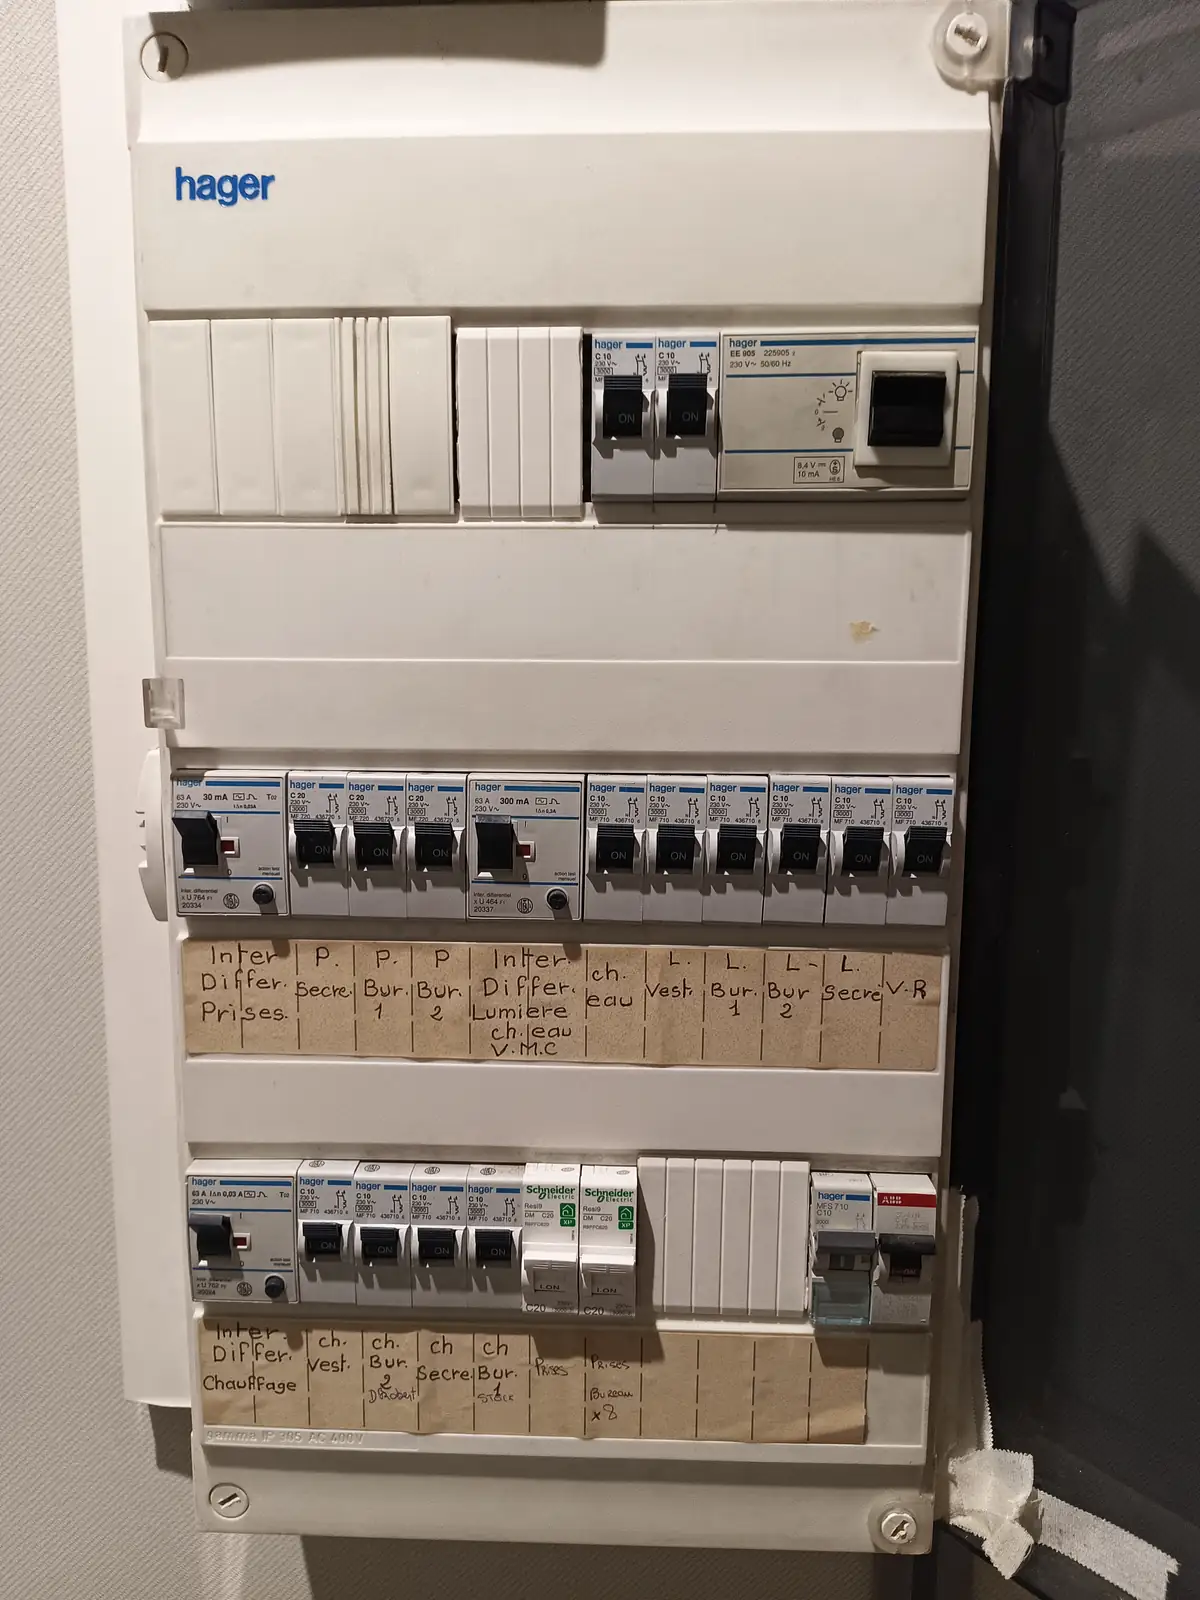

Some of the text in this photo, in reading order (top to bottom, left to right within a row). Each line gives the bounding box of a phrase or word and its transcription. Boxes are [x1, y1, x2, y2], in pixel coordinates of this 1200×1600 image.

[176, 166, 276, 207] hager
[594, 339, 623, 350] hager
[658, 338, 686, 349] hager
[729, 338, 758, 348] hager
[760, 360, 780, 368] 50/60
[290, 780, 316, 789] hager
[348, 782, 375, 791] hager
[408, 783, 434, 793] hager
[474, 782, 501, 792] hager
[589, 783, 616, 793] hager
[649, 783, 676, 793] hager
[710, 783, 737, 793] hager
[773, 783, 799, 793] hager
[834, 784, 862, 794] hager
[896, 785, 923, 795] hager
[670, 852, 686, 860] ON
[316, 946, 339, 967] P.
[376, 950, 398, 968] P.
[435, 950, 449, 968] P
[495, 947, 571, 968] Inter.
[670, 951, 690, 966] L.
[727, 953, 746, 969] L.
[841, 955, 859, 972] L.
[592, 962, 626, 981] ch.
[202, 969, 287, 991] Differ.
[483, 976, 576, 996] Differ.
[295, 982, 352, 998] Secre.
[364, 979, 408, 997] Bur.
[418, 981, 462, 999] Bur.
[645, 978, 692, 998] Vest.
[711, 982, 757, 998] Bur.
[767, 982, 810, 1000] Bur
[586, 995, 633, 1007] eau
[729, 1000, 740, 1016] 1
[202, 1001, 288, 1022] Prises.
[375, 1003, 382, 1019] 1
[430, 1006, 444, 1021] 2
[472, 1004, 568, 1021] Lumiere
[780, 1003, 792, 1019] 2
[491, 1021, 572, 1040] ch. eau
[491, 1042, 558, 1057] V.M.C
[192, 1177, 216, 1186] hager
[300, 1177, 324, 1186] hager
[356, 1181, 380, 1191] hager
[412, 1183, 436, 1192] hager
[468, 1185, 493, 1194] hager
[526, 1186, 576, 1195] Schneider
[585, 1188, 634, 1198] Schneider
[818, 1192, 844, 1200] hager
[816, 1202, 848, 1211] MFS 710
[882, 1195, 902, 1204] ABB
[526, 1303, 546, 1312] C20
[584, 1307, 604, 1315] C20
[217, 1322, 287, 1340] Inter.
[319, 1330, 347, 1348] ch.
[372, 1333, 399, 1350] ch.
[430, 1335, 453, 1355] ch
[483, 1334, 508, 1355] ch
[213, 1342, 292, 1362] Differ.
[308, 1353, 350, 1372] Vest.
[370, 1355, 408, 1368] Bur.
[416, 1365, 473, 1380] Secre.
[478, 1366, 517, 1380] Bur.
[203, 1375, 296, 1394] Chauffage
[380, 1374, 392, 1390] 2
[493, 1382, 501, 1396] 1
[207, 1431, 256, 1442] gamma
[261, 1431, 275, 1442] IP
[308, 1433, 326, 1444] AC
